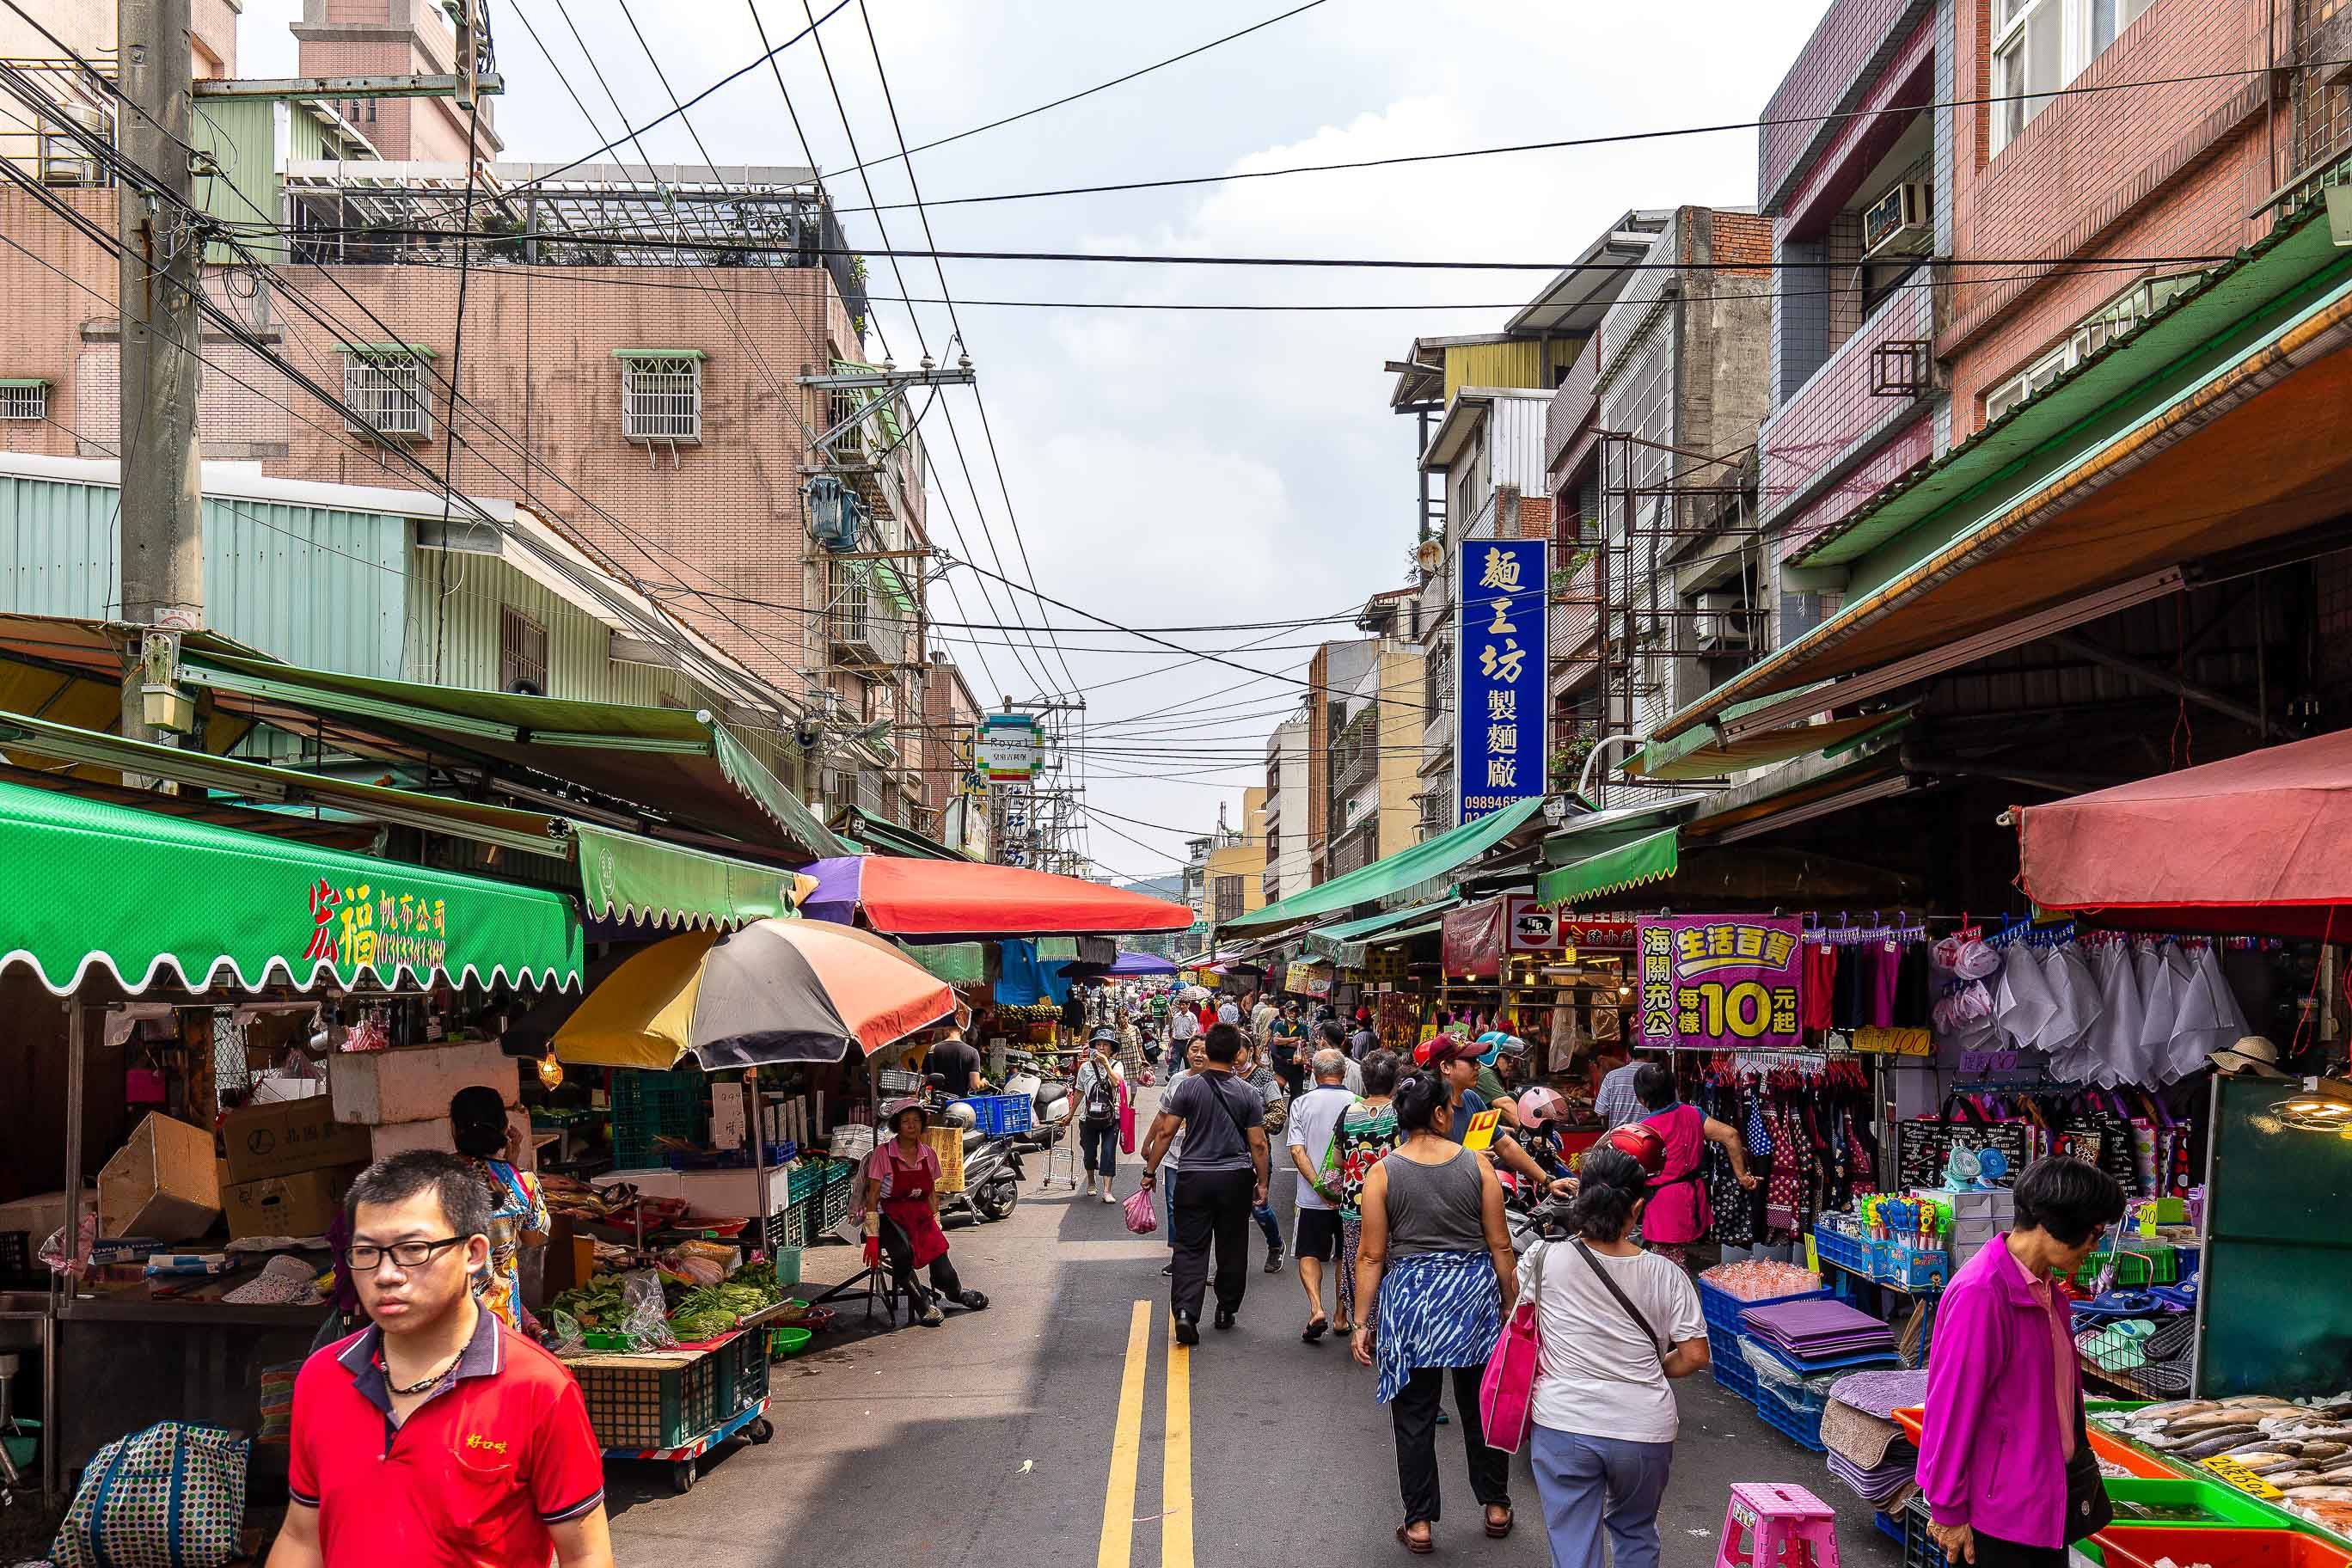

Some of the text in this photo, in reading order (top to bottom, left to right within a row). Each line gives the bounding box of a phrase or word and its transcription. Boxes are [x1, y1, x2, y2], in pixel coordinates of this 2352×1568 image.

[1465, 796, 1534, 809] 0989465
[378, 890, 445, 937] 帆布公司
[1677, 926, 1795, 965] 生活百貨
[1643, 928, 1672, 1037] 海關充公
[1678, 983, 1796, 1038] 每樣 10 元起
[1468, 1110, 1498, 1132] 10
[2141, 1208, 2156, 1225] 20
